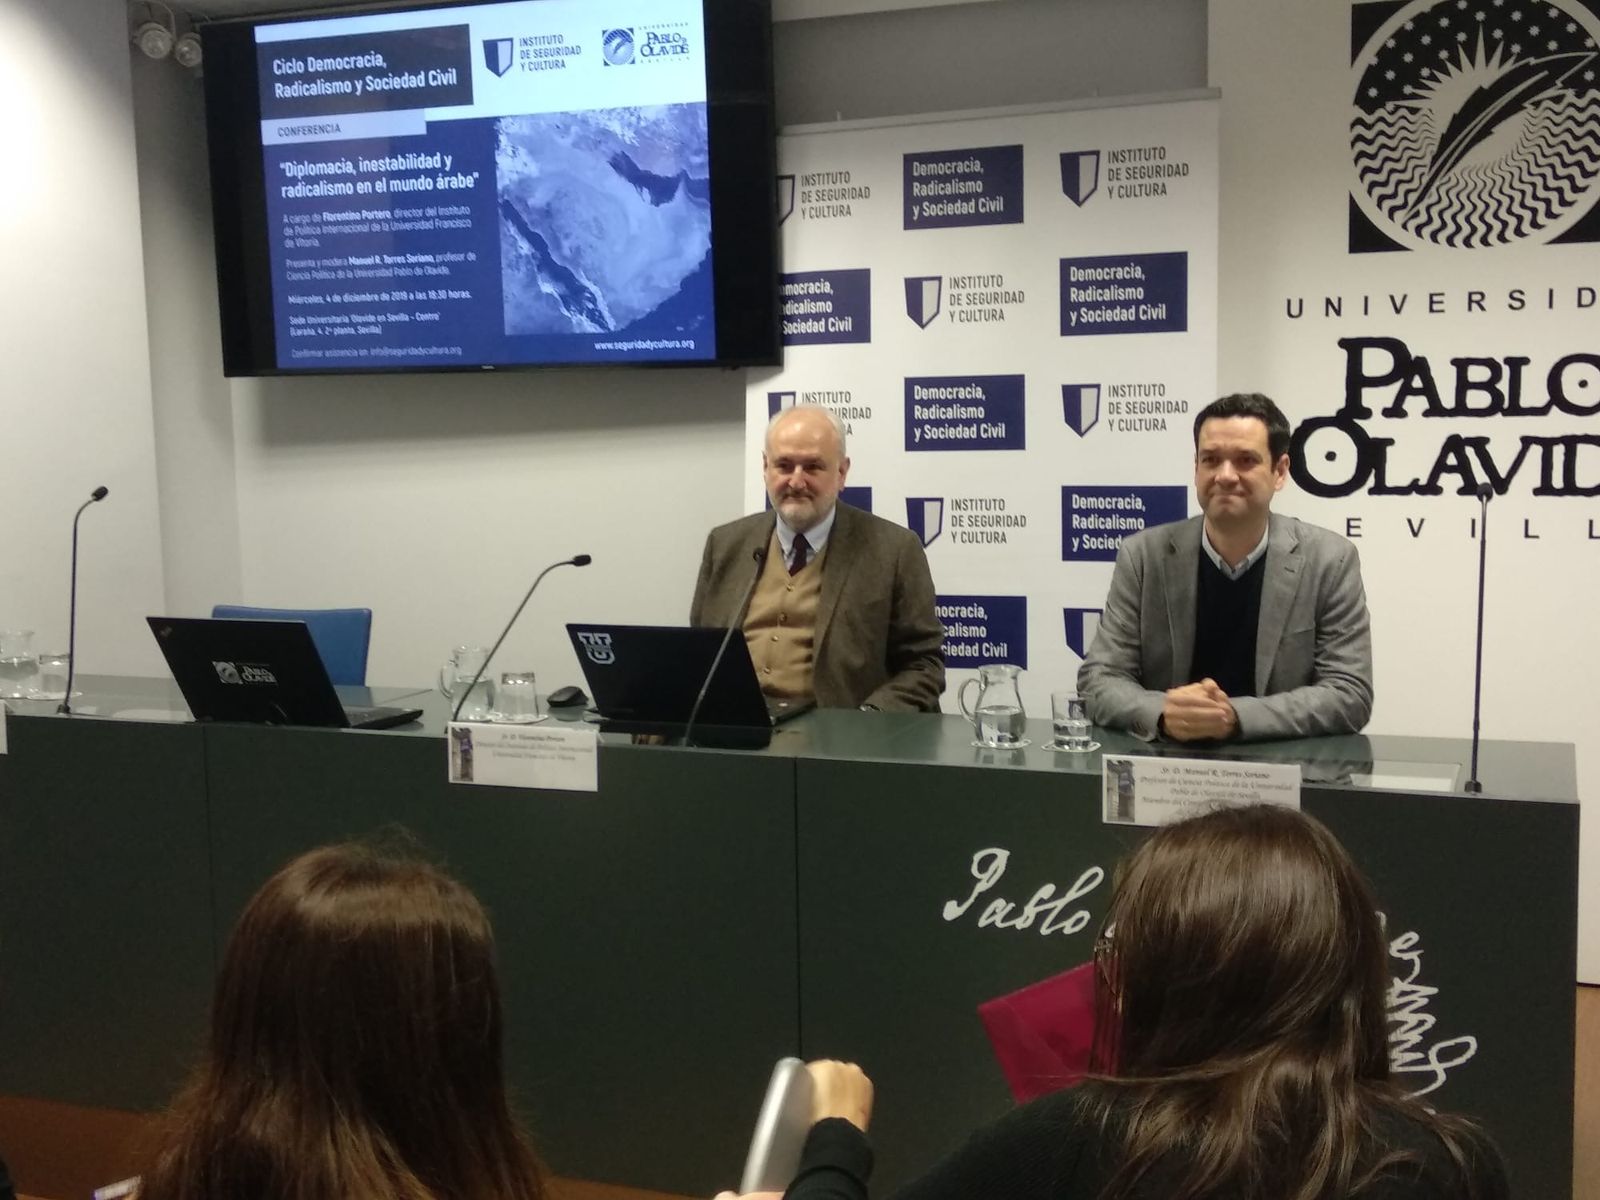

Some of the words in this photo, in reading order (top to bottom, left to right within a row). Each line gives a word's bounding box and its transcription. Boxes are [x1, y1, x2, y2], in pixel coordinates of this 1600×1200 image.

[519, 34, 564, 47] INSTITUTO
[520, 48, 531, 60] DE
[533, 45, 582, 59] SEGURIDAD
[273, 58, 304, 75] Ciclo
[307, 51, 387, 73] Democracia,
[520, 62, 527, 72] Y
[528, 59, 566, 72] CULTURA
[275, 78, 352, 98] Radicalismo
[355, 79, 362, 96] y
[366, 71, 425, 91] Sociedad
[429, 68, 457, 86] Civil
[278, 123, 341, 137] CONFERENCIA
[359, 152, 441, 172] inestabilidad
[444, 155, 452, 171] y
[1108, 146, 1166, 164] INSTITUTO
[912, 157, 984, 176] Democracia,
[1108, 167, 1121, 181] DE
[1125, 163, 1189, 181] SEGURIDAD
[281, 178, 356, 199] radicalismo
[357, 180, 372, 195] en
[375, 177, 387, 193] el
[389, 175, 434, 192] mundo
[801, 171, 850, 186] INSTITUTO
[801, 190, 812, 203] DE
[815, 186, 871, 202] SEGURIDAD
[913, 179, 983, 197] Radicalismo
[1108, 186, 1115, 199] Y
[1118, 182, 1167, 199] CULTURA
[801, 208, 807, 220] Y
[809, 205, 851, 219] CULTURA
[912, 204, 920, 221] y
[922, 197, 975, 217] Sociedad
[978, 196, 1004, 214] Civil
[1070, 262, 1145, 282] Democracia,
[783, 278, 833, 296] mocracia,
[950, 275, 1004, 290] INSTITUTO
[950, 294, 962, 306] DE
[965, 290, 1025, 306] SEGURIDAD
[1070, 285, 1144, 303] Radicalismo
[950, 311, 955, 323] Y
[958, 308, 1004, 323] CULTURA
[1070, 309, 1077, 327] y
[1080, 304, 1135, 323] Sociedad
[1139, 304, 1166, 320] Civil
[783, 318, 825, 335] Sociedad
[828, 316, 852, 332] Civil
[594, 339, 695, 351] www.seguridadycultura.org
[1337, 337, 1600, 420] PABLO
[802, 391, 851, 404] INSTITUTO
[914, 383, 986, 401] Democracia,
[1108, 383, 1166, 398] INSTITUTO
[914, 404, 985, 420] Radicalismo
[1108, 401, 1122, 415] DE
[1125, 400, 1188, 414] SEGURIDAD
[914, 427, 921, 442] y
[924, 423, 977, 439] Sociedad
[980, 422, 1005, 439] Civil
[1108, 419, 1115, 432] Y
[1118, 418, 1167, 432] CULTURA
[951, 498, 1005, 511] INSTITUTO
[1072, 493, 1146, 512] Democracia,
[951, 515, 964, 528] DE
[967, 514, 1027, 528] SEGURIDAD
[1072, 514, 1145, 531] Radicalismo
[1345, 517, 1600, 540] EVILL
[951, 532, 957, 544] Y
[960, 531, 1007, 545] CULTURA
[1072, 536, 1079, 552] y
[1082, 534, 1122, 550] Socied
[943, 622, 987, 638] calismo
[982, 642, 1007, 657] Civil
[942, 847, 1104, 936] Pablo
